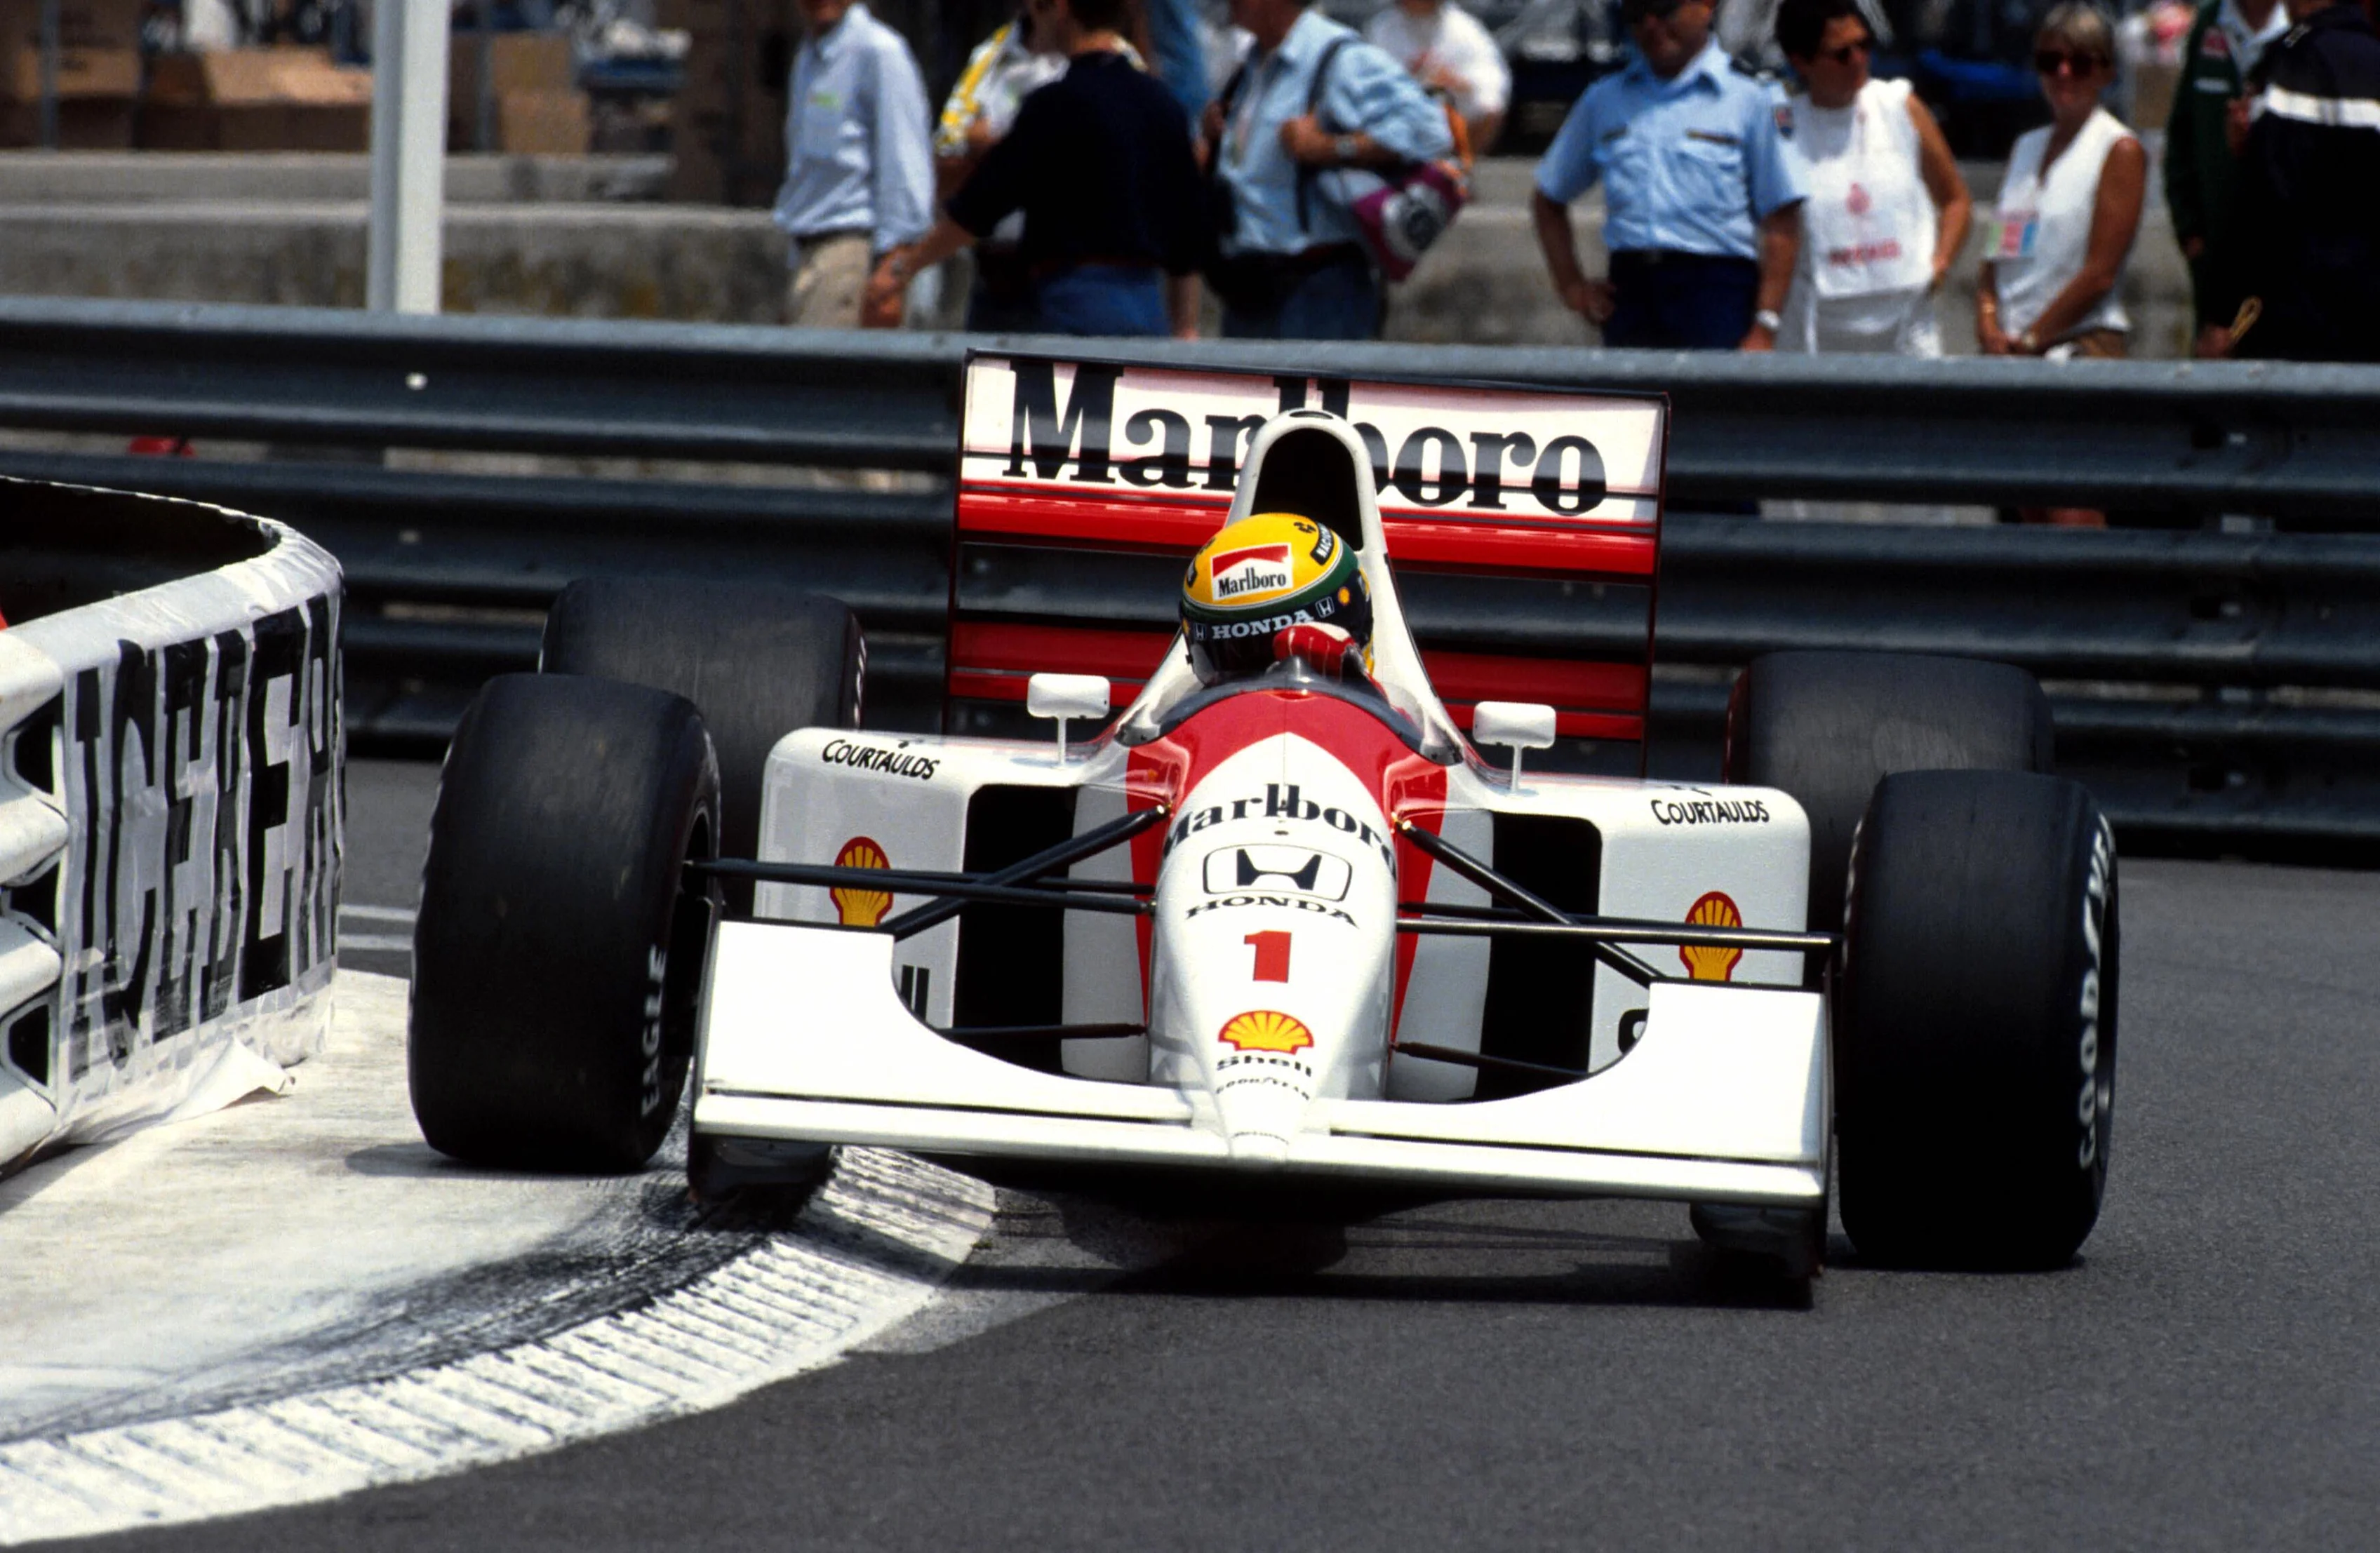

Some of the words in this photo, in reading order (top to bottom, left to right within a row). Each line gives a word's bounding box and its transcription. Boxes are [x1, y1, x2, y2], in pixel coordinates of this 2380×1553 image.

[1217, 567, 1287, 597] Marlboro
[1212, 609, 1314, 639] HONDA
[822, 739, 941, 780] COURTAULDS
[1650, 799, 1770, 826] COURTAULDS
[1186, 896, 1360, 929] HONDA
[1244, 930, 1292, 983] 1
[641, 943, 667, 1117] EAGLE
[1216, 1055, 1312, 1077] Shell
